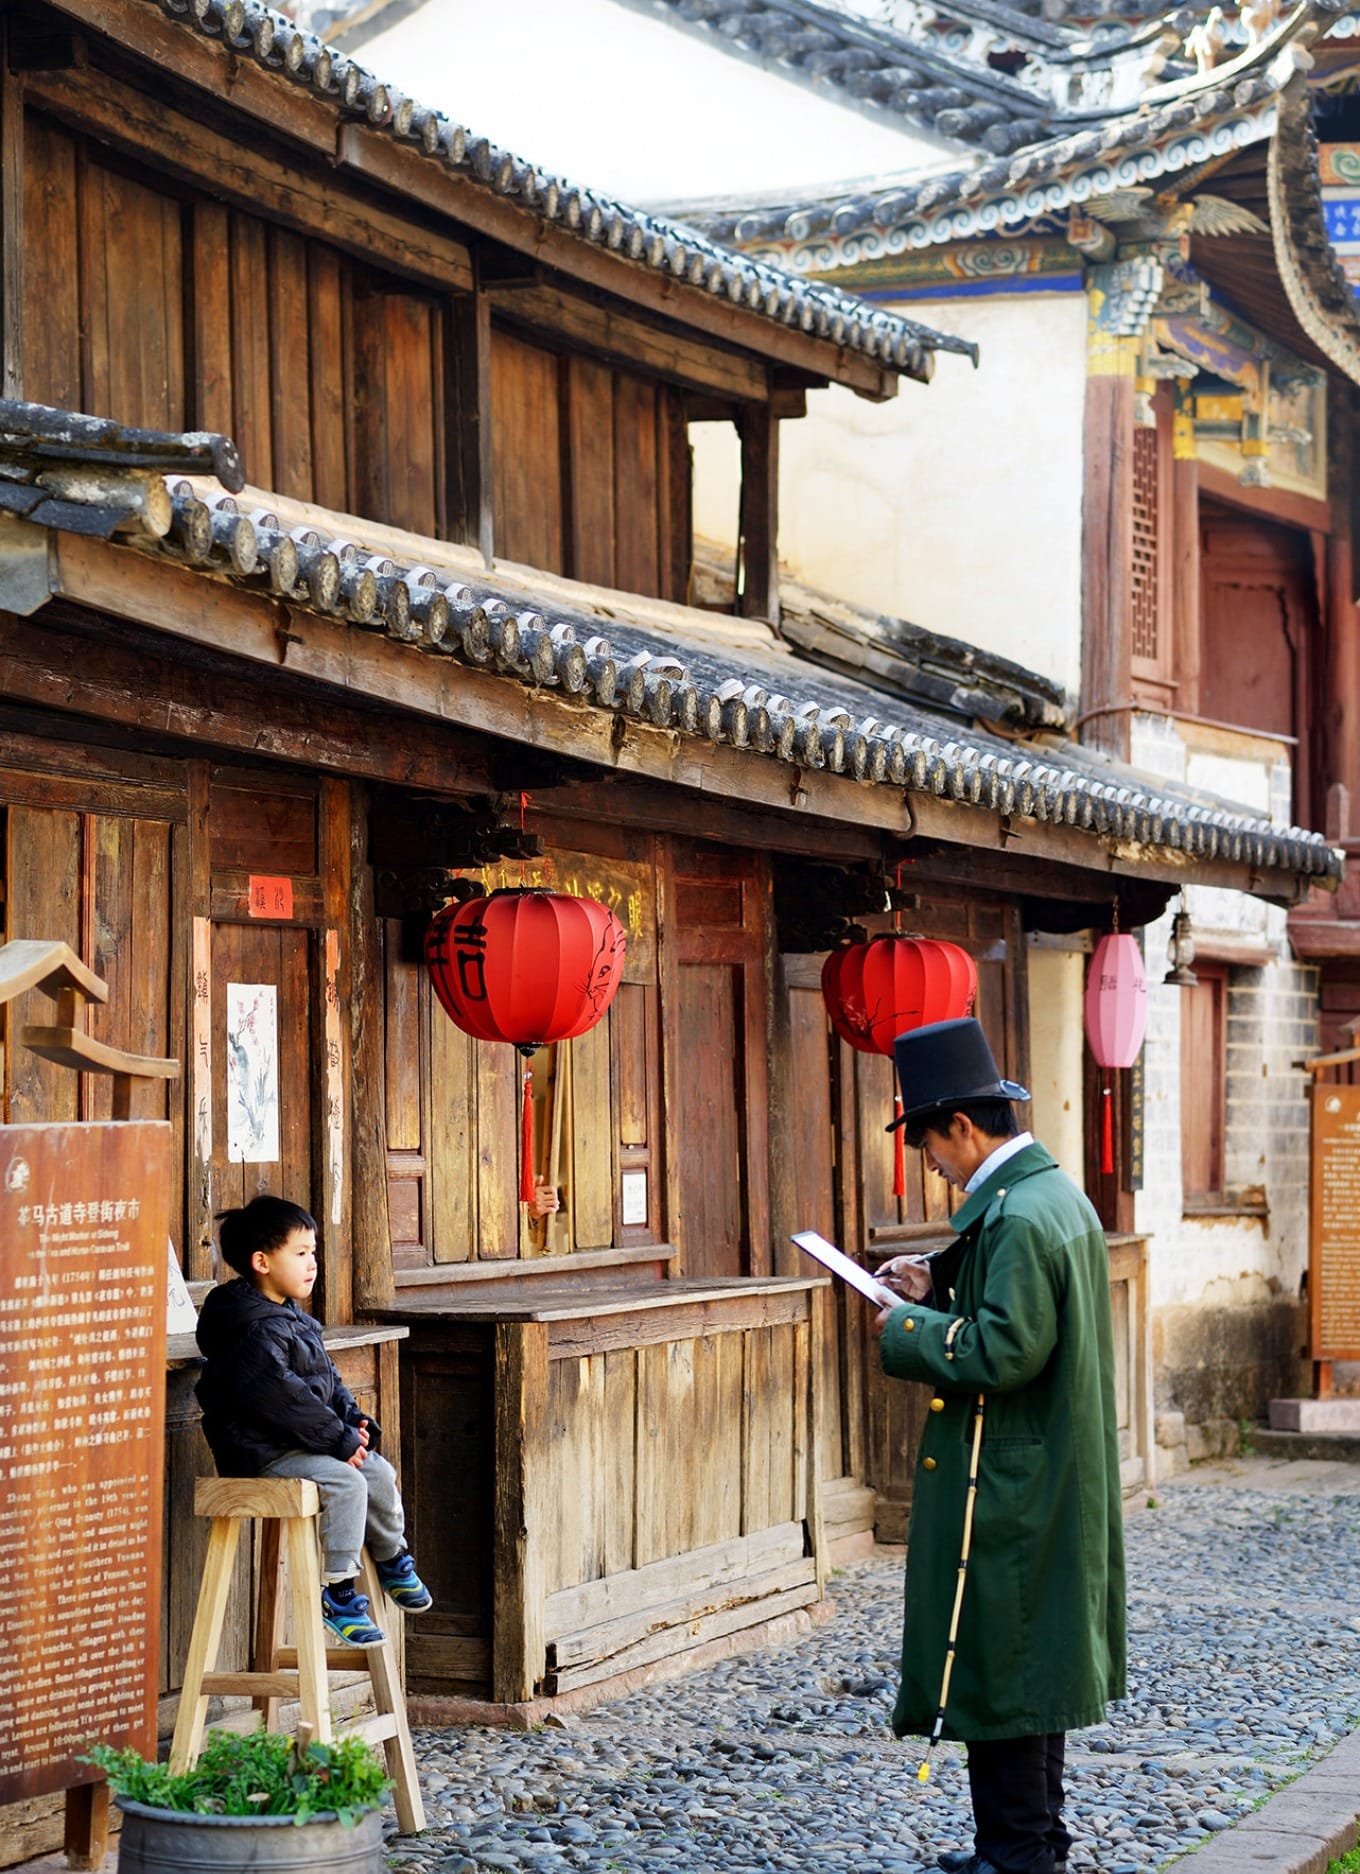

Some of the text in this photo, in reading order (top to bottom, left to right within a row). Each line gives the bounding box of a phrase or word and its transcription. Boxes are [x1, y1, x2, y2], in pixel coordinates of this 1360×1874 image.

[18, 1198, 140, 1226] 茶马古道寺登街夜市
[62, 1485, 77, 1494] who
[100, 1475, 136, 1490] appointed
[85, 1497, 97, 1506] the
[83, 1527, 96, 1538] and
[48, 1549, 61, 1559] and
[49, 1581, 61, 1591] the
[58, 1595, 77, 1605] There
[79, 1592, 90, 1601] are
[91, 1586, 118, 1598] markets
[94, 1603, 117, 1613] during
[119, 1599, 130, 1608] the
[79, 1635, 108, 1648] villagers
[111, 1630, 126, 1641] with
[28, 1663, 41, 1674] and
[64, 1658, 76, 1666] are
[79, 1653, 88, 1663] all
[91, 1651, 106, 1661] over
[108, 1647, 120, 1657] the
[55, 1674, 74, 1684] Some
[75, 1667, 103, 1680] villagers
[104, 1665, 116, 1673] are
[17, 1698, 35, 1708] some
[36, 1695, 48, 1704] are
[49, 1688, 79, 1701] drinking
[116, 1676, 133, 1686] some
[134, 1673, 145, 1682] are
[16, 1713, 29, 1724] and
[62, 1703, 76, 1714] and
[77, 1700, 96, 1710] some
[97, 1697, 108, 1706] are
[110, 1690, 136, 1703] fighting
[12, 1730, 35, 1741] Lovers
[36, 1727, 48, 1736] are
[49, 1719, 80, 1732] following
[95, 1710, 119, 1722] custom
[128, 1702, 145, 1714] meet
[24, 1740, 50, 1754] Around
[86, 1728, 101, 1739] half
[113, 1722, 131, 1733] them
[134, 1717, 145, 1729] get
[10, 1762, 23, 1773] and
